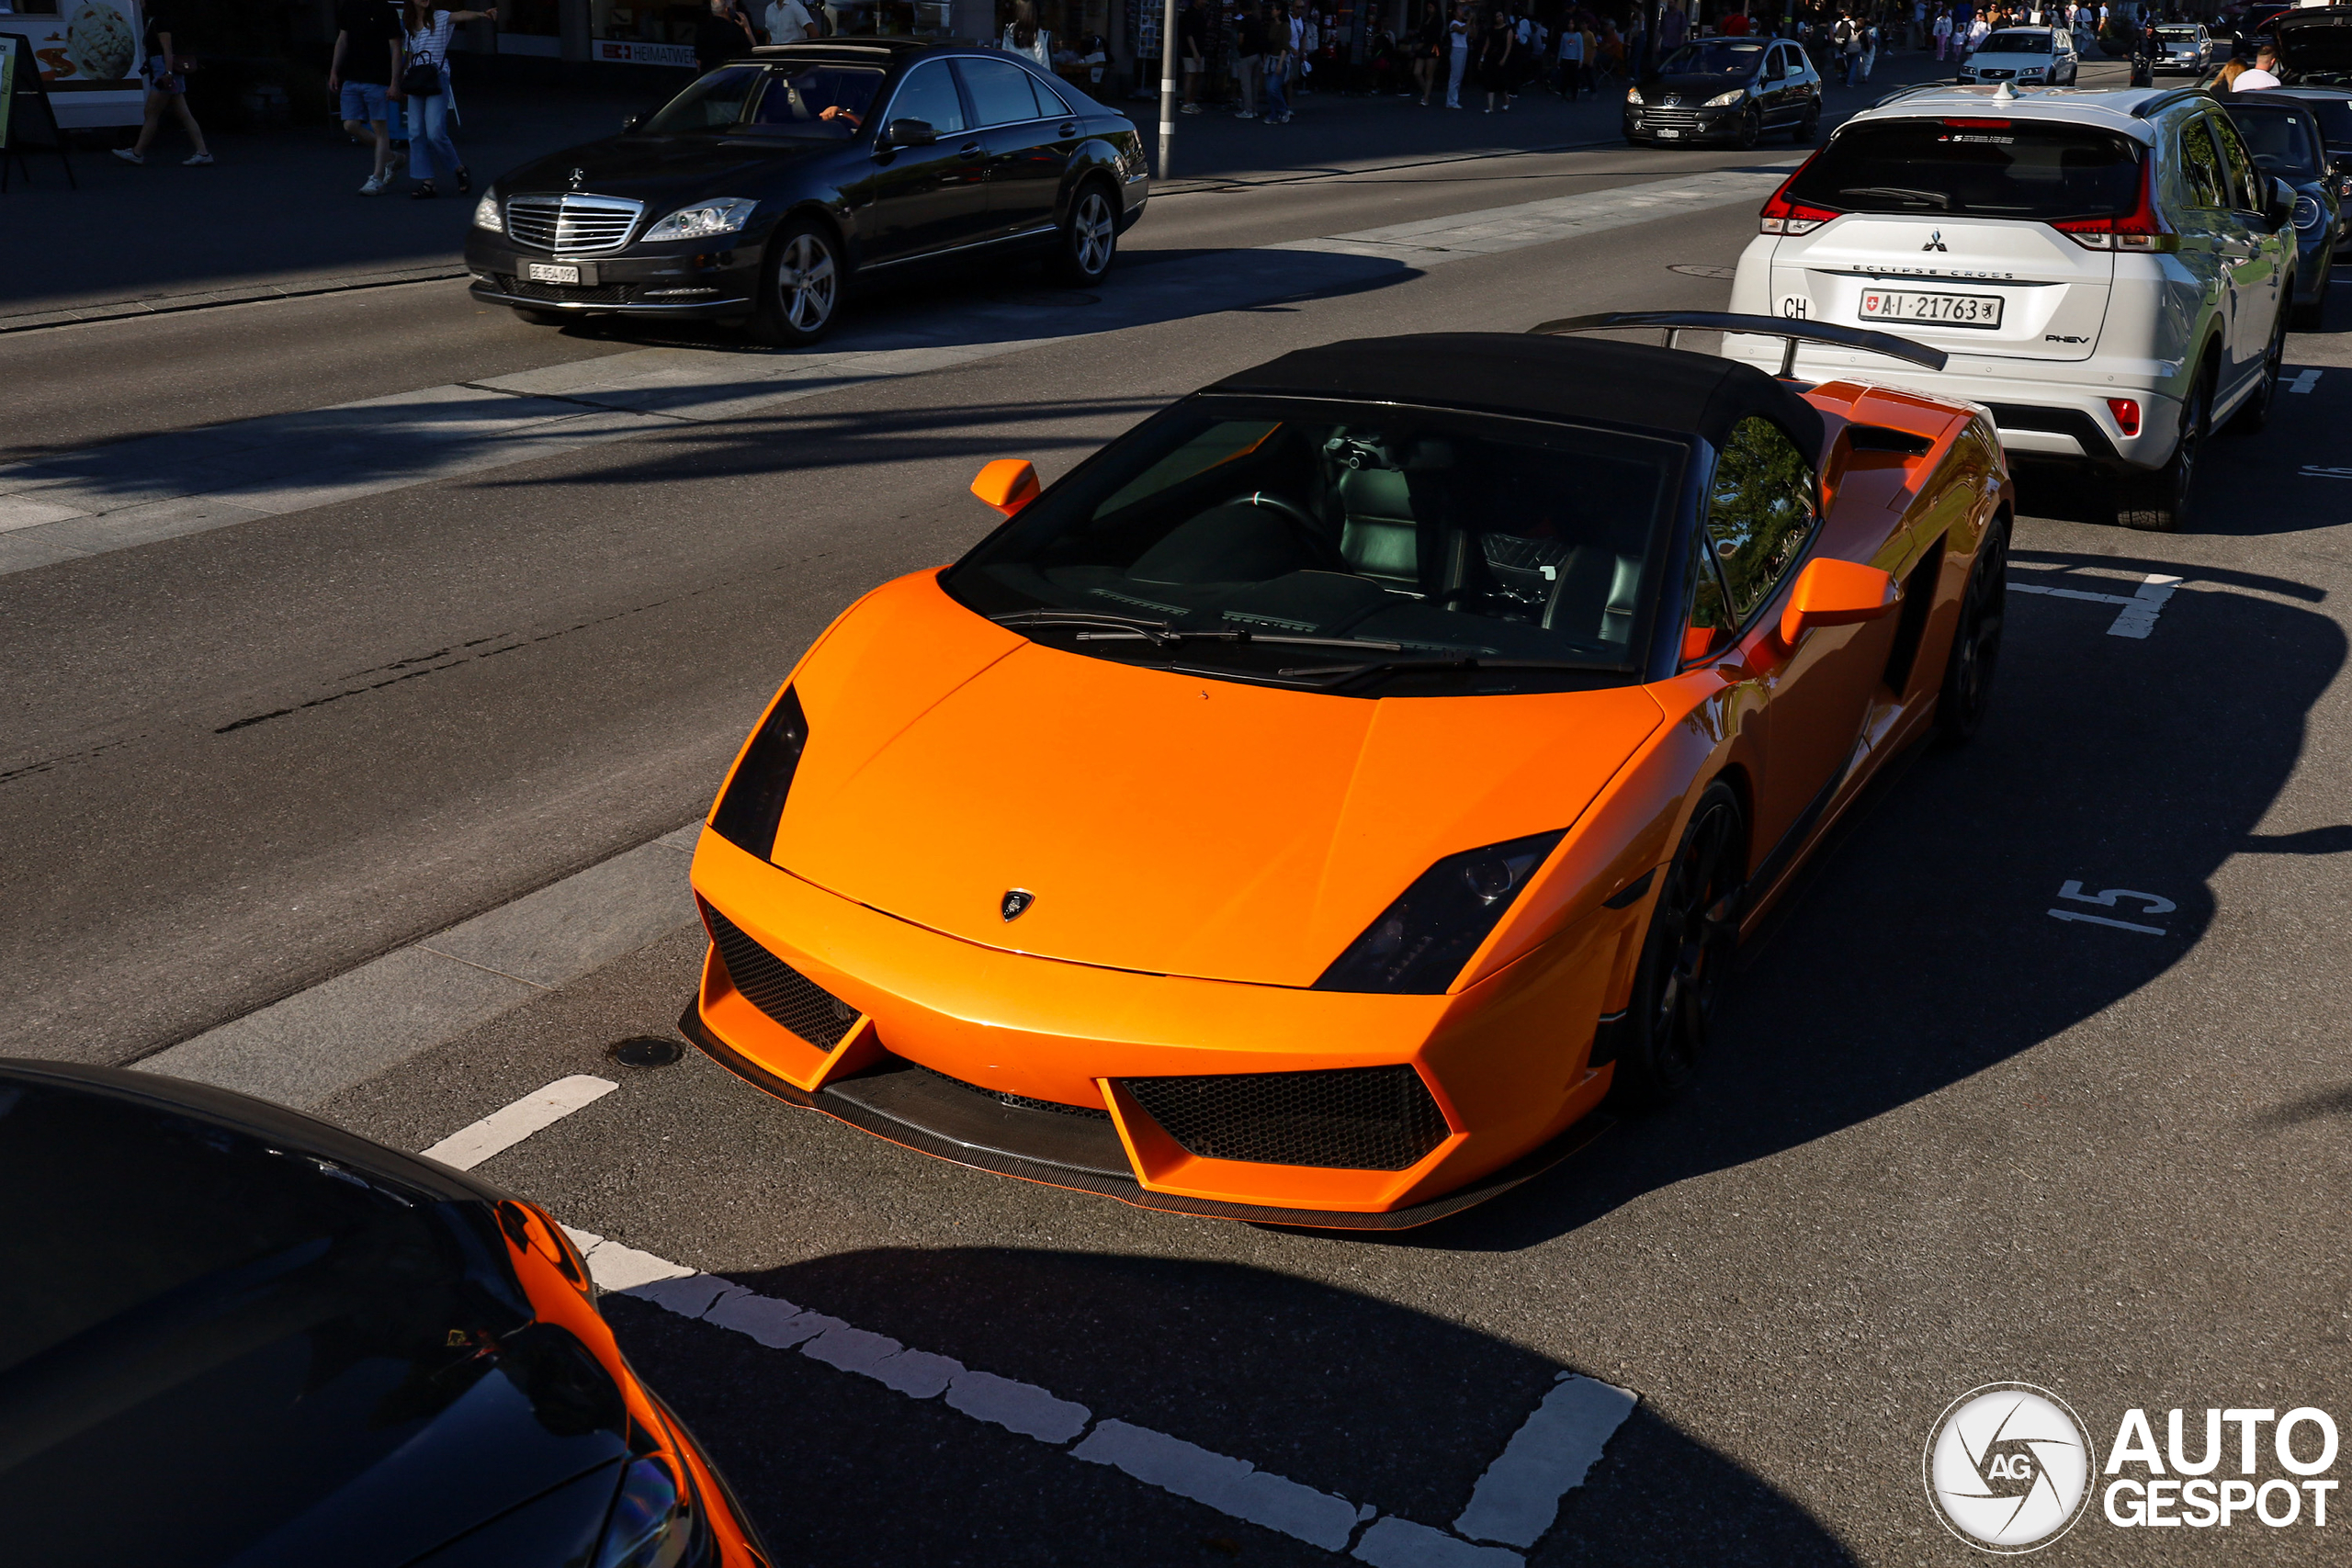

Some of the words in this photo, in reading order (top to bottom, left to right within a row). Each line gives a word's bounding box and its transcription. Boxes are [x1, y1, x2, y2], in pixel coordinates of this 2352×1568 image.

[634, 45, 697, 64] HEIMATWER
[1852, 265, 1938, 275] ECLIPSE
[1951, 270, 2013, 279] CROSS
[1783, 298, 1807, 320] CH
[2045, 334, 2090, 344] PHEV
[2046, 879, 2177, 936] 15
